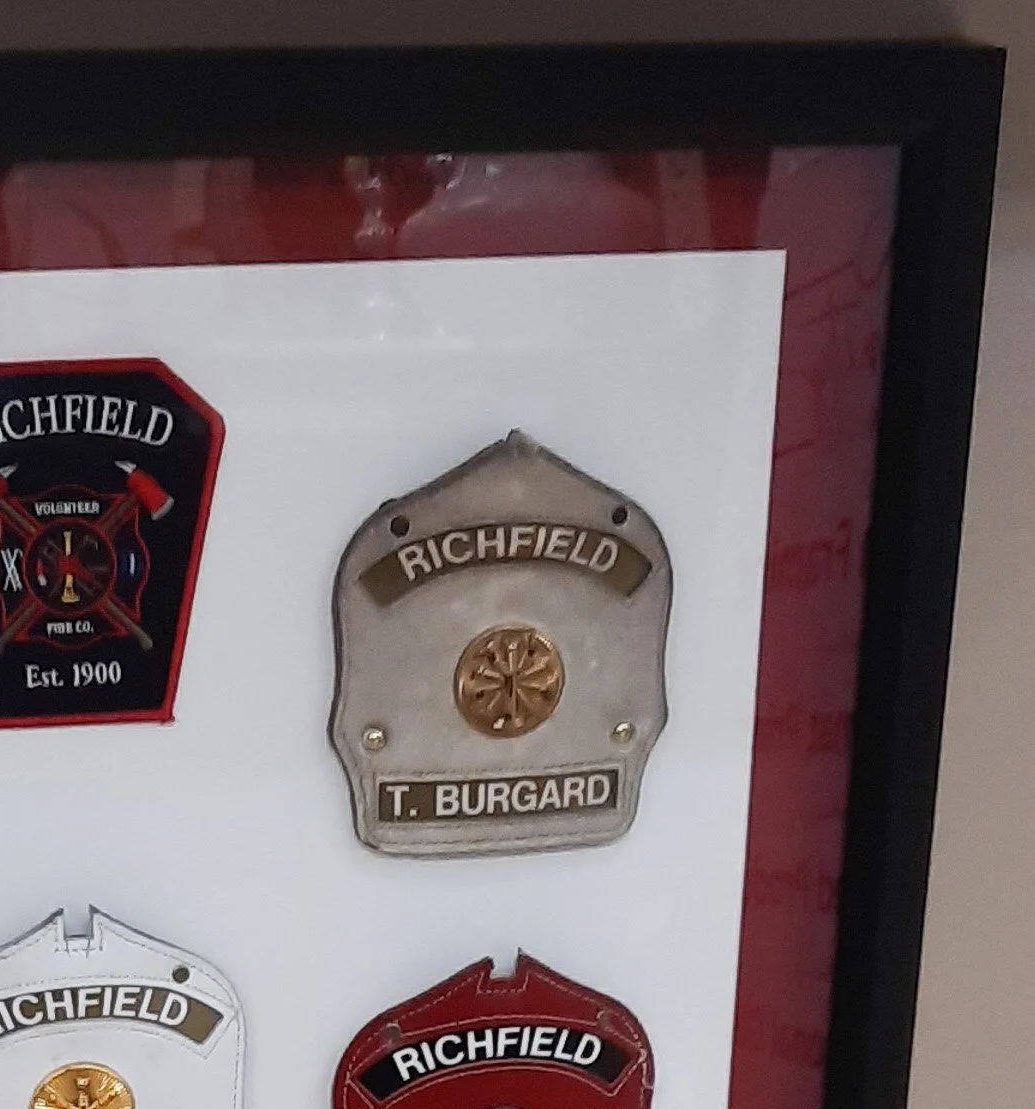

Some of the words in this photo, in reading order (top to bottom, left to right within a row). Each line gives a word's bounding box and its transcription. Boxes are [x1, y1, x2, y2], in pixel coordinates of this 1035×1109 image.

[397, 525, 618, 582] RICHFIELD
[24, 663, 63, 688] Est.
[73, 661, 122, 687] 1900
[385, 784, 419, 816] T.
[435, 774, 610, 816] BURGARD
[392, 1026, 602, 1082] RICHFIELD
